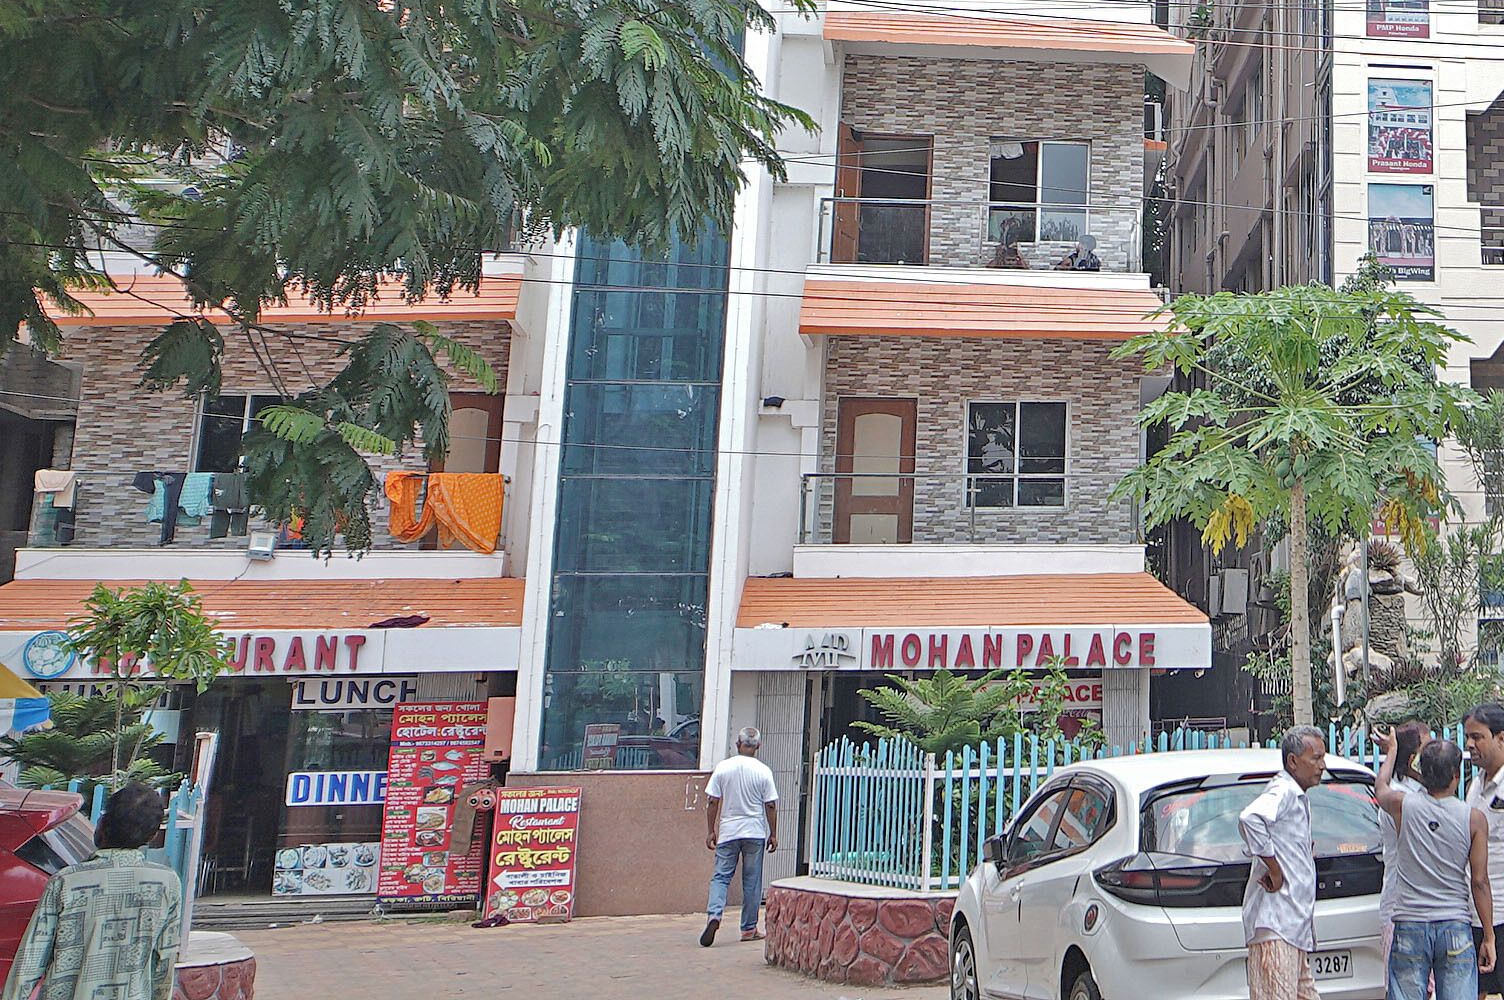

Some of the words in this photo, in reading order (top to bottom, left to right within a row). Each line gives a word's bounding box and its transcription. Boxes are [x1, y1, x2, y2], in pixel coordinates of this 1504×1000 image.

[871, 633, 1003, 669] MOHAN
[1016, 632, 1156, 667] PALACE
[297, 680, 417, 705] LUNCH
[398, 714, 436, 724] মোহন
[292, 773, 388, 804] DINNE
[500, 798, 539, 814] MOHAN
[539, 796, 579, 813] PALACE
[508, 814, 566, 830] Restaurant
[496, 829, 532, 846] মোহন
[531, 828, 575, 844] প্যালেস
[1315, 955, 1349, 975] 3287
